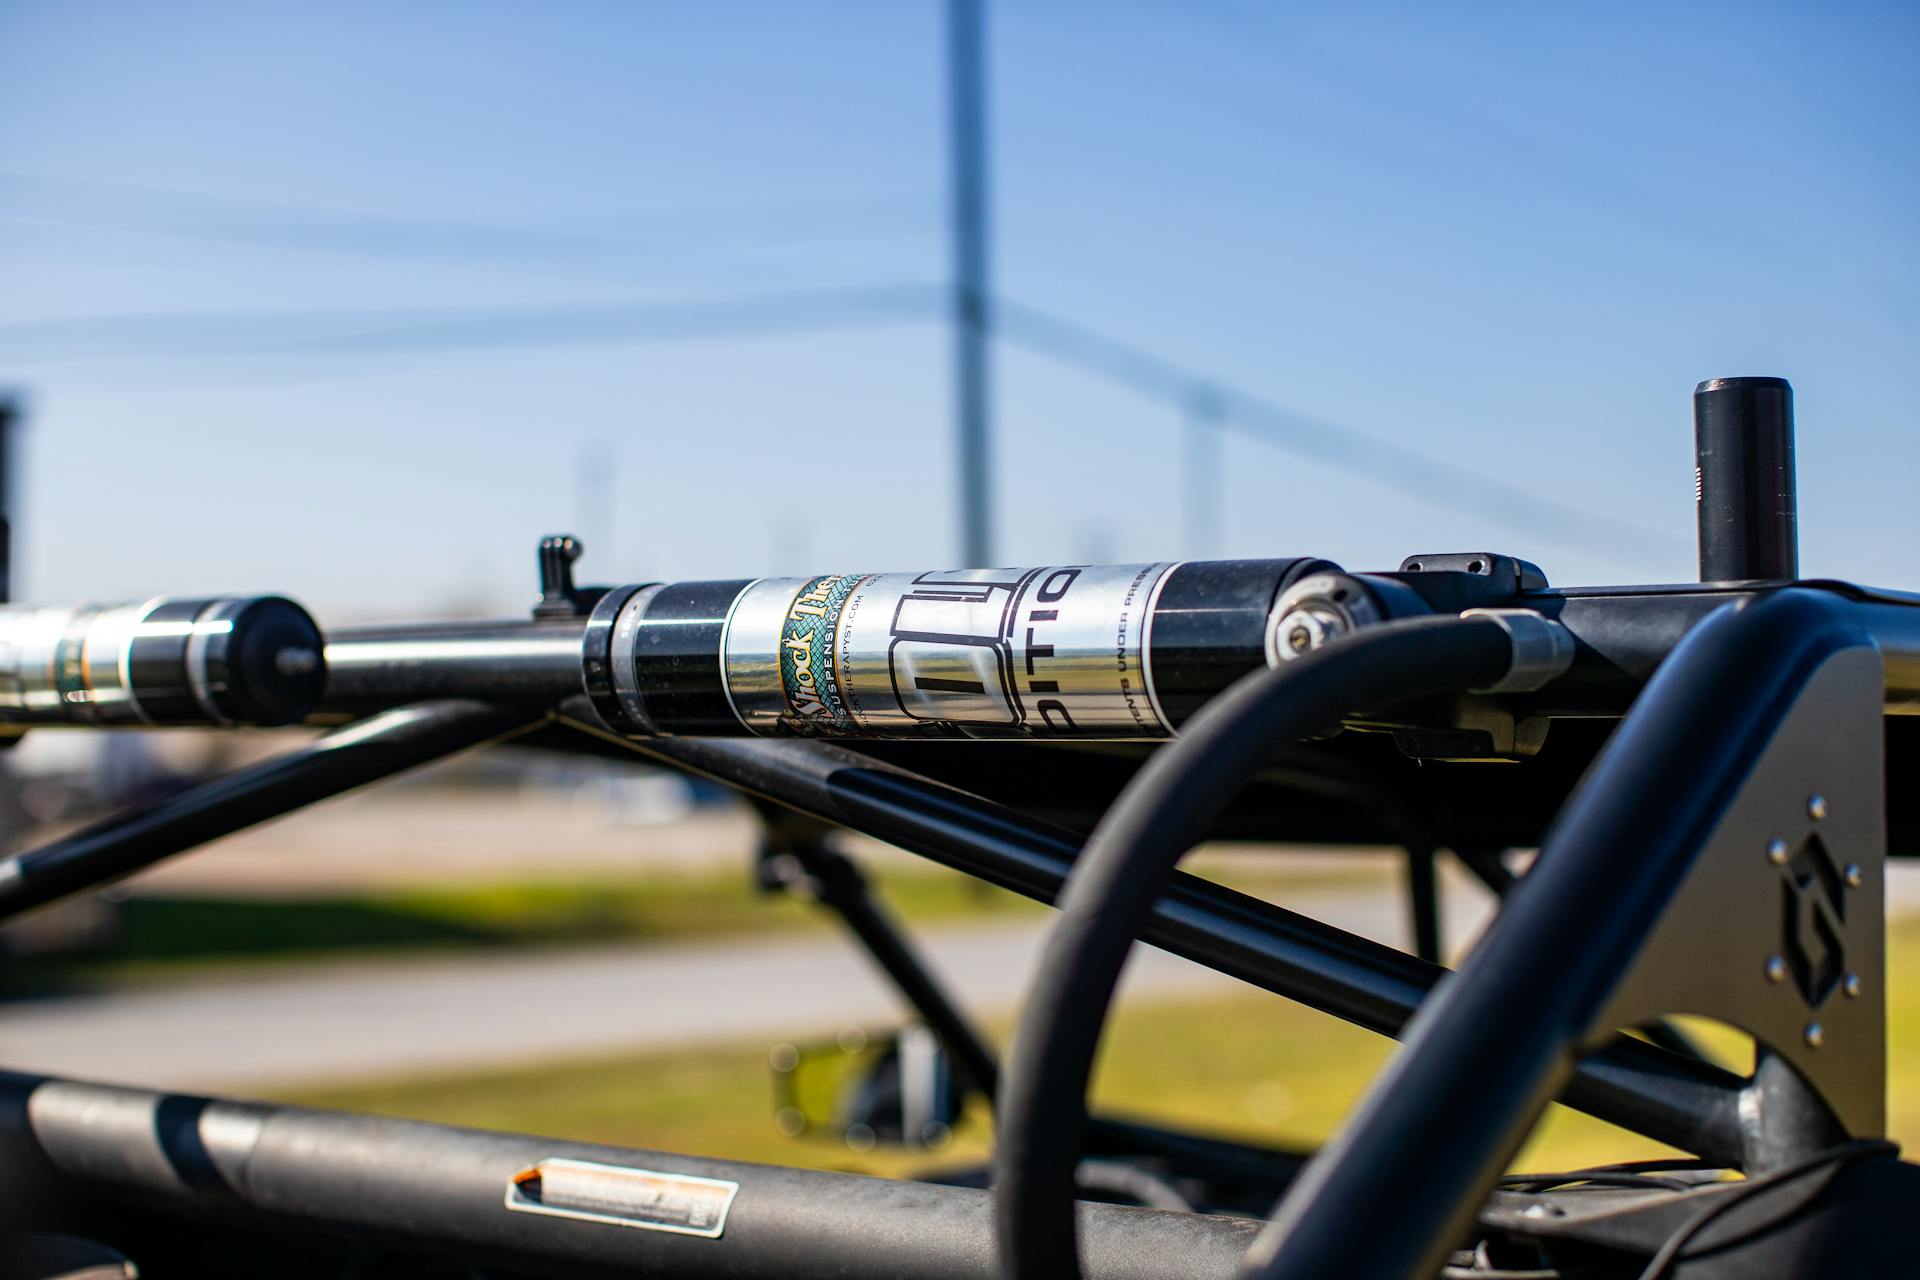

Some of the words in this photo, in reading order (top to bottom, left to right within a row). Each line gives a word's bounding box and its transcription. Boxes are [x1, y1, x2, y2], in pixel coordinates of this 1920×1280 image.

[782, 627, 835, 719] Shock
[823, 599, 846, 716] SUSPENSION
[1117, 612, 1129, 672] UNDER
